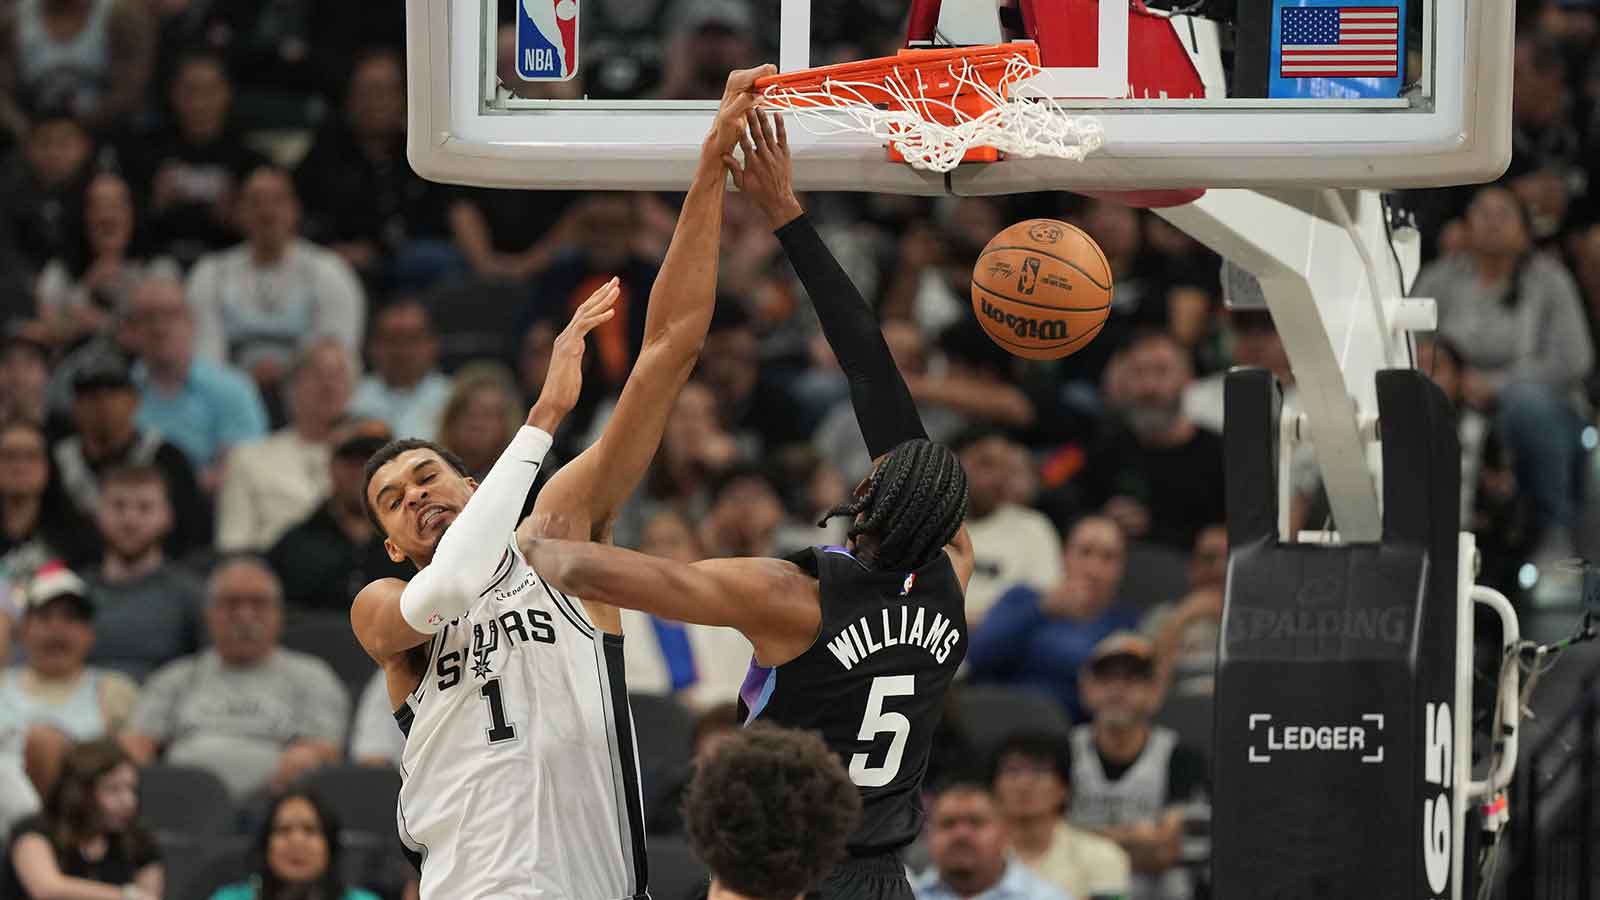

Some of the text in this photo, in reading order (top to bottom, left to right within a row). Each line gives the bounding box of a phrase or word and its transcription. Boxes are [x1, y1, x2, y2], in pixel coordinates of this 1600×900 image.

[524, 48, 554, 72] NBA
[980, 296, 1070, 340] Wilson
[500, 578, 531, 599] LEDGER
[436, 608, 556, 692] SURS
[826, 604, 961, 671] WILLIAMS
[1229, 604, 1407, 643] SPALDING
[480, 677, 517, 744] 1
[848, 674, 916, 787] 5
[1267, 726, 1366, 750] LEDGER
[1423, 702, 1453, 900] 65
